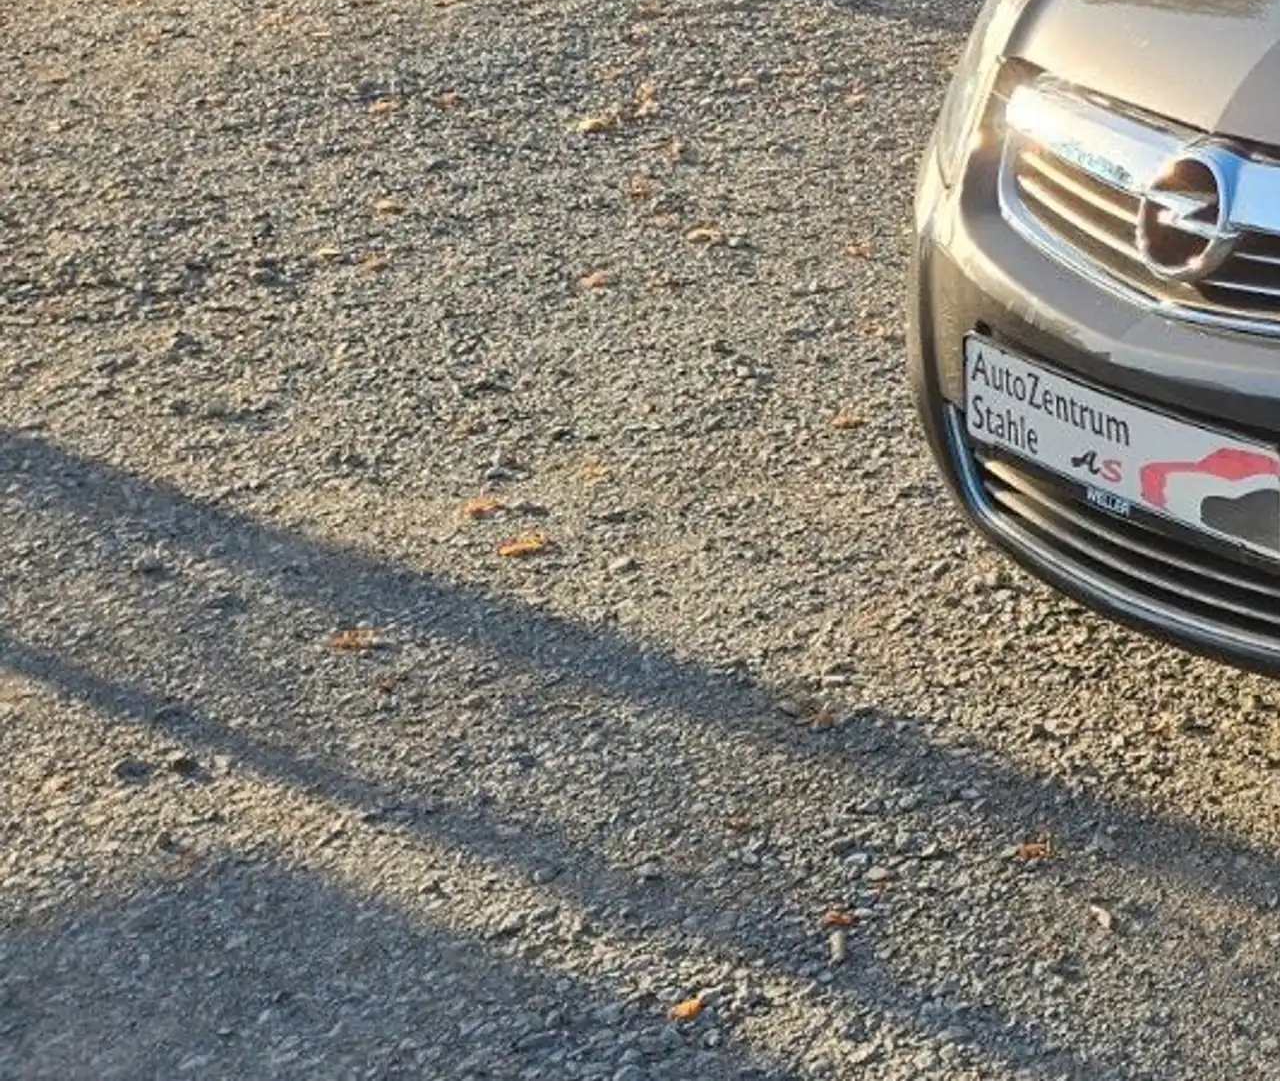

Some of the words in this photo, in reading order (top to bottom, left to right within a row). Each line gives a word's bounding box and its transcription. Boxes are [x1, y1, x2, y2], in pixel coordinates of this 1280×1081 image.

[971, 350, 1130, 447] AutoZentrum
[972, 394, 1039, 456] Stahle
[1070, 450, 1123, 483] AS
